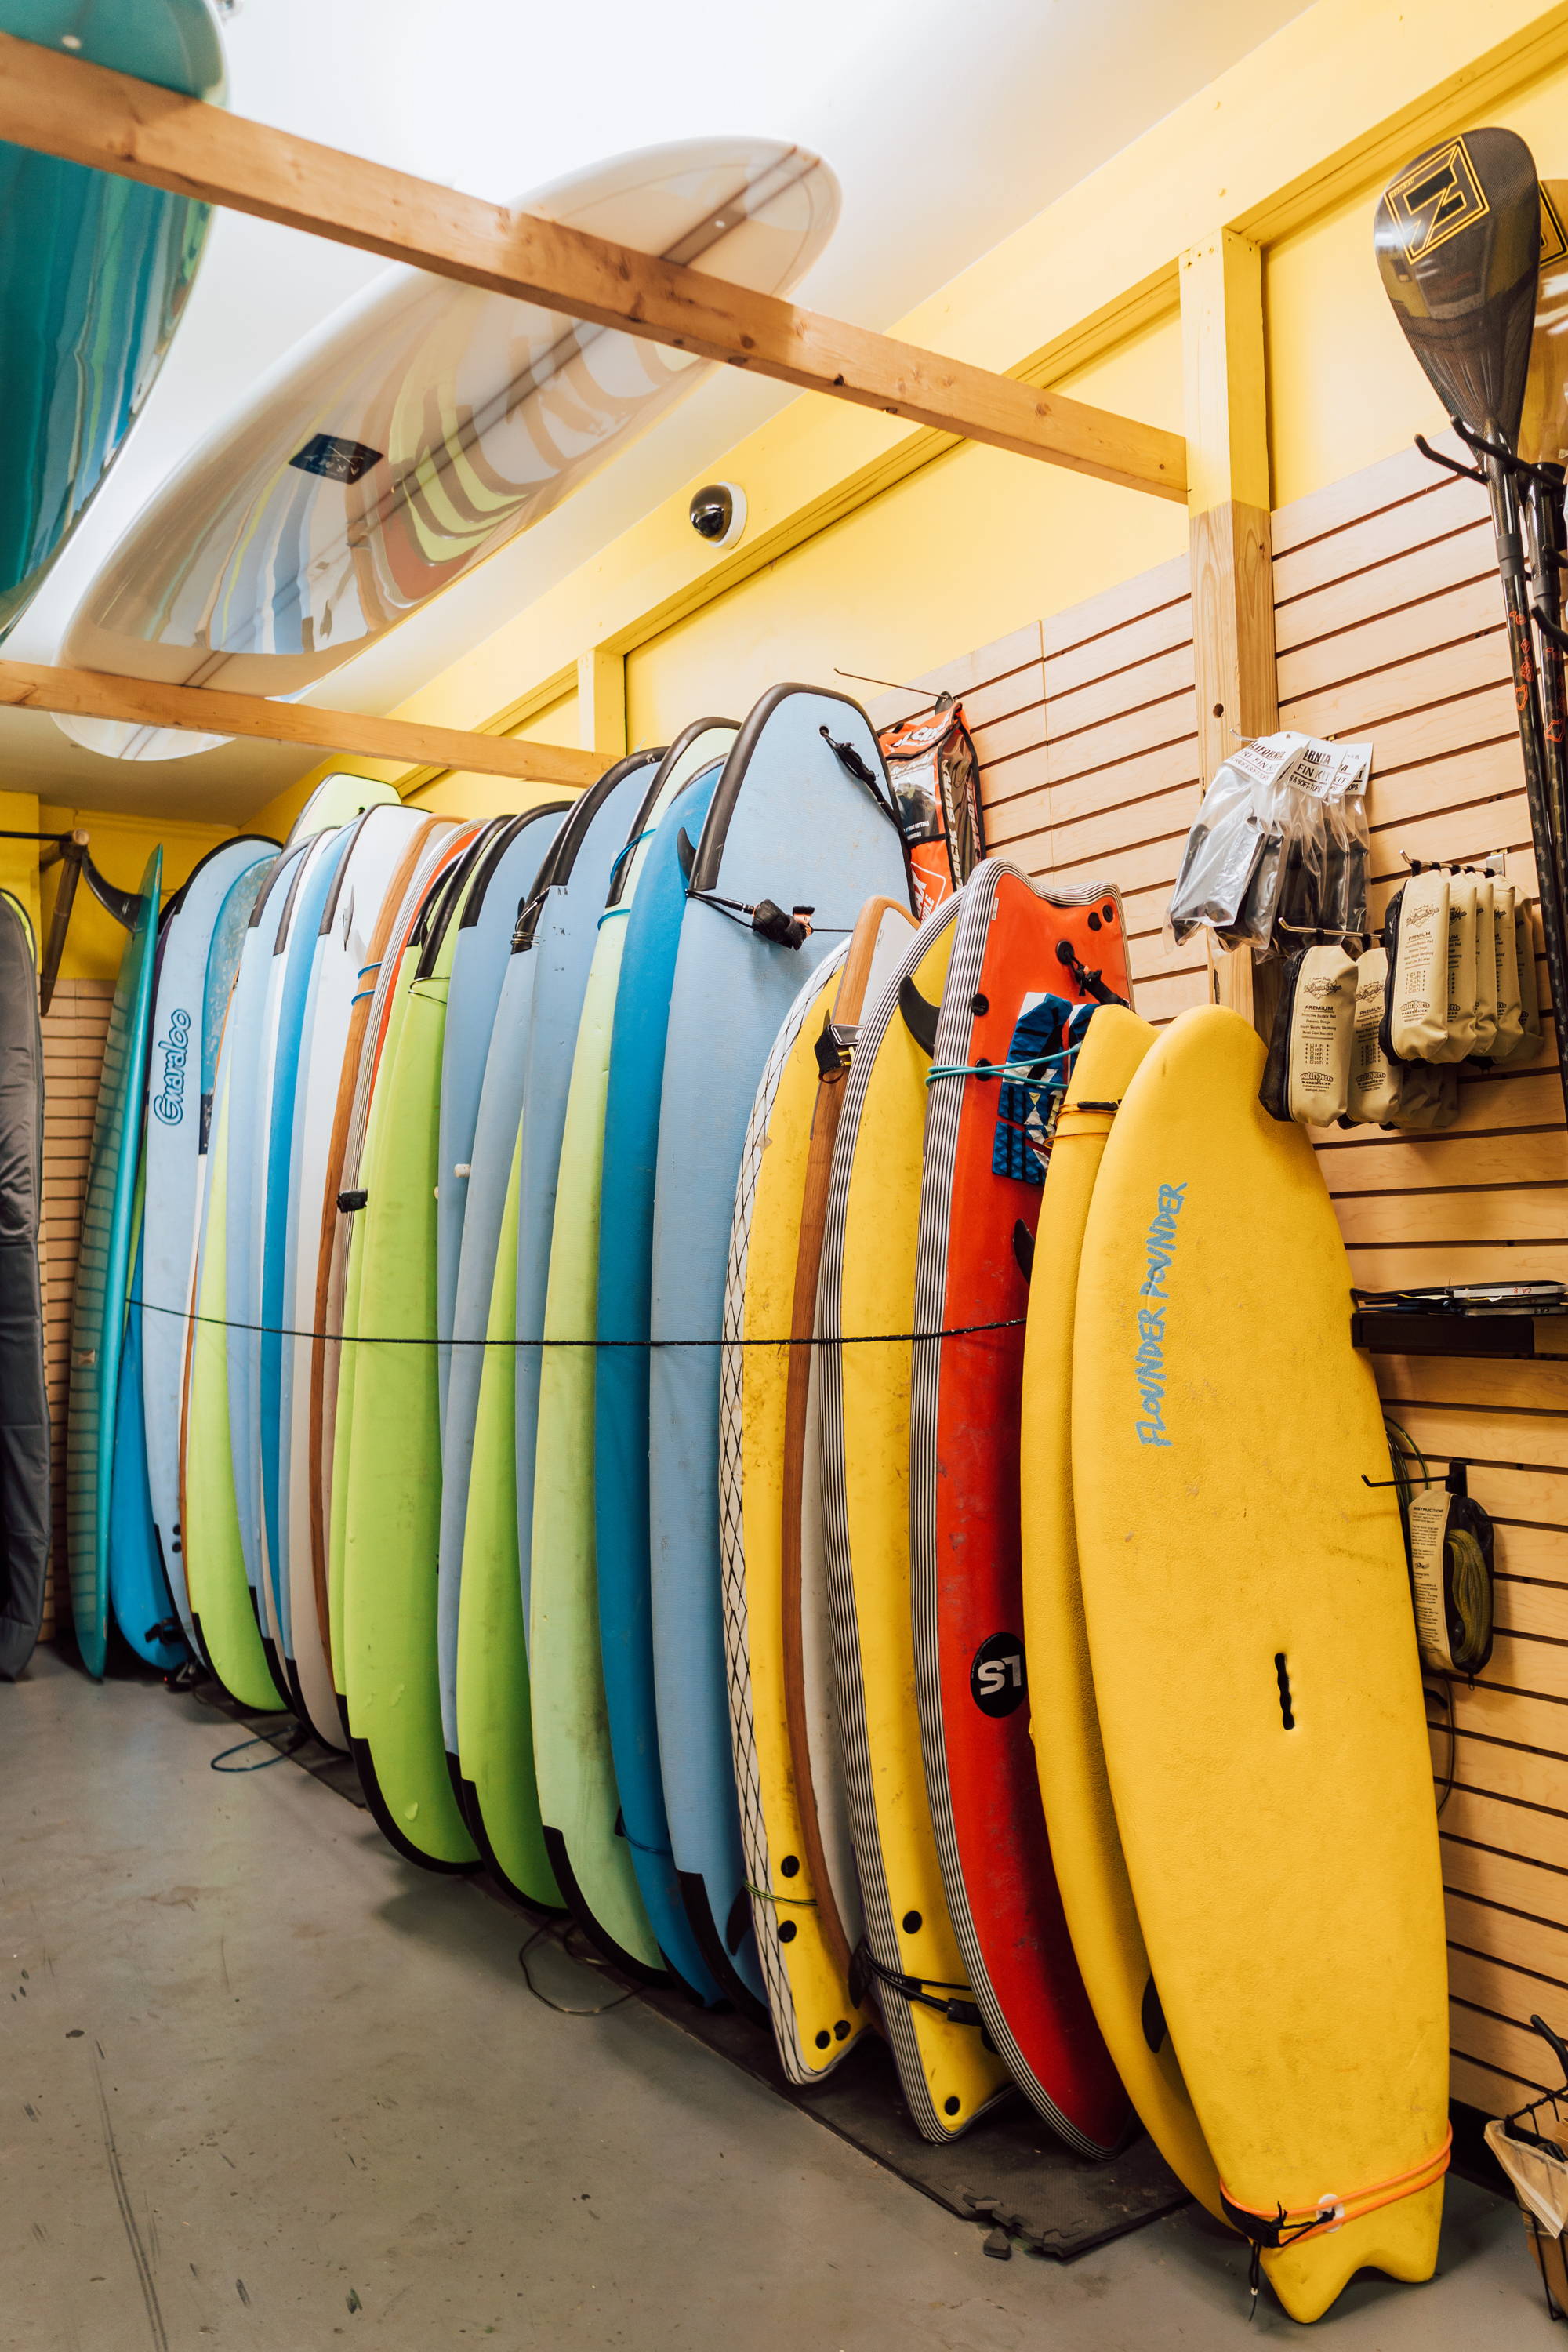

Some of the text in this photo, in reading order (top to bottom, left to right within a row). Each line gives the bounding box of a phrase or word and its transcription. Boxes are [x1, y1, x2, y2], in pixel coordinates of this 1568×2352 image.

[1297, 763, 1315, 778] FIN
[949, 828, 964, 892] LOCK
[1359, 1005, 1383, 1016] PREMIUM
[1134, 1182, 1188, 1446] FLOUNDER POUNDER
